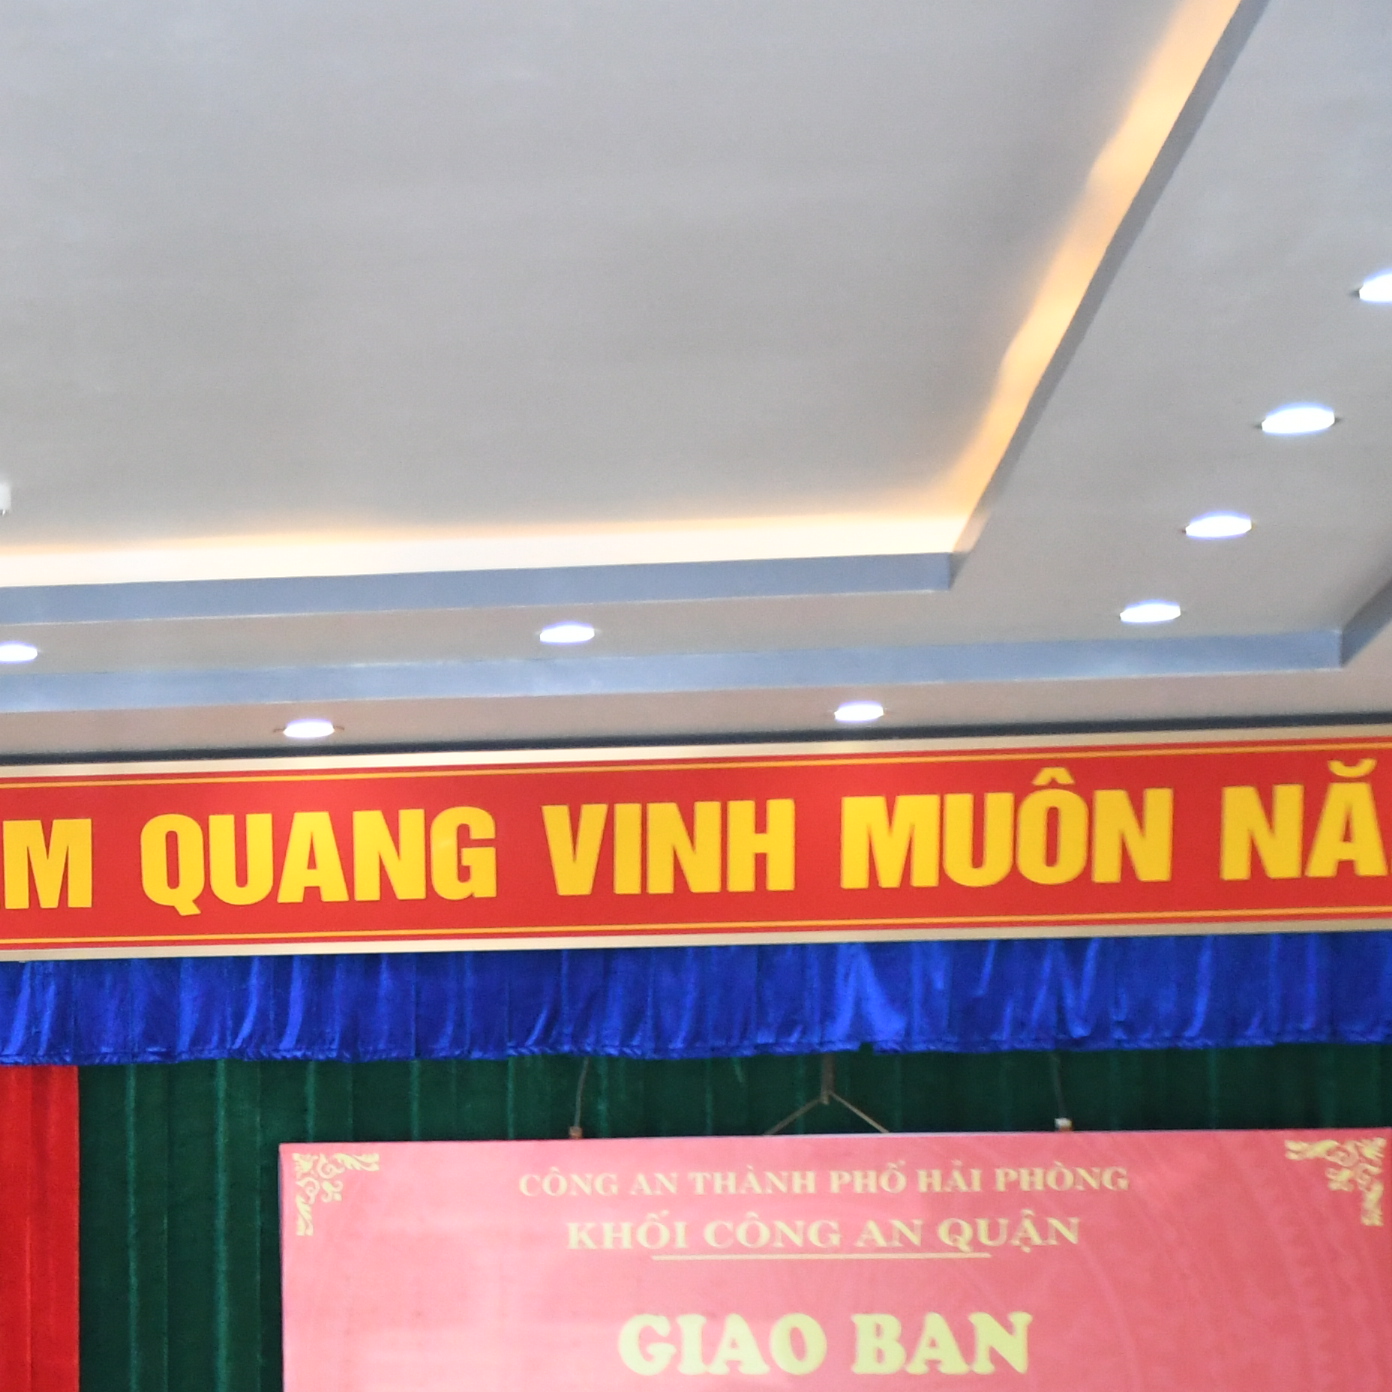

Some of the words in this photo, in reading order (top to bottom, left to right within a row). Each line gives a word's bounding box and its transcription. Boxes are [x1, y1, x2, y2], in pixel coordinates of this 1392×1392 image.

[140, 806, 497, 916] QUANG
[542, 798, 796, 896] VINH
[838, 764, 1174, 889] MUÔN
[1220, 757, 1391, 881] NĂ
[518, 1165, 620, 1197] CÔNG
[631, 1172, 678, 1196] AN
[688, 1164, 817, 1195] THÀNH
[828, 1160, 908, 1194] PHỐ
[917, 1159, 983, 1194] HẢI
[995, 1159, 1131, 1193] PHÒNG
[567, 1209, 689, 1250] KHỐI
[703, 1211, 843, 1248] CÔNG
[854, 1218, 925, 1248] AN
[936, 1207, 1081, 1254] QUẬN
[618, 1311, 829, 1377] GIAO
[851, 1310, 1035, 1377] BAN
